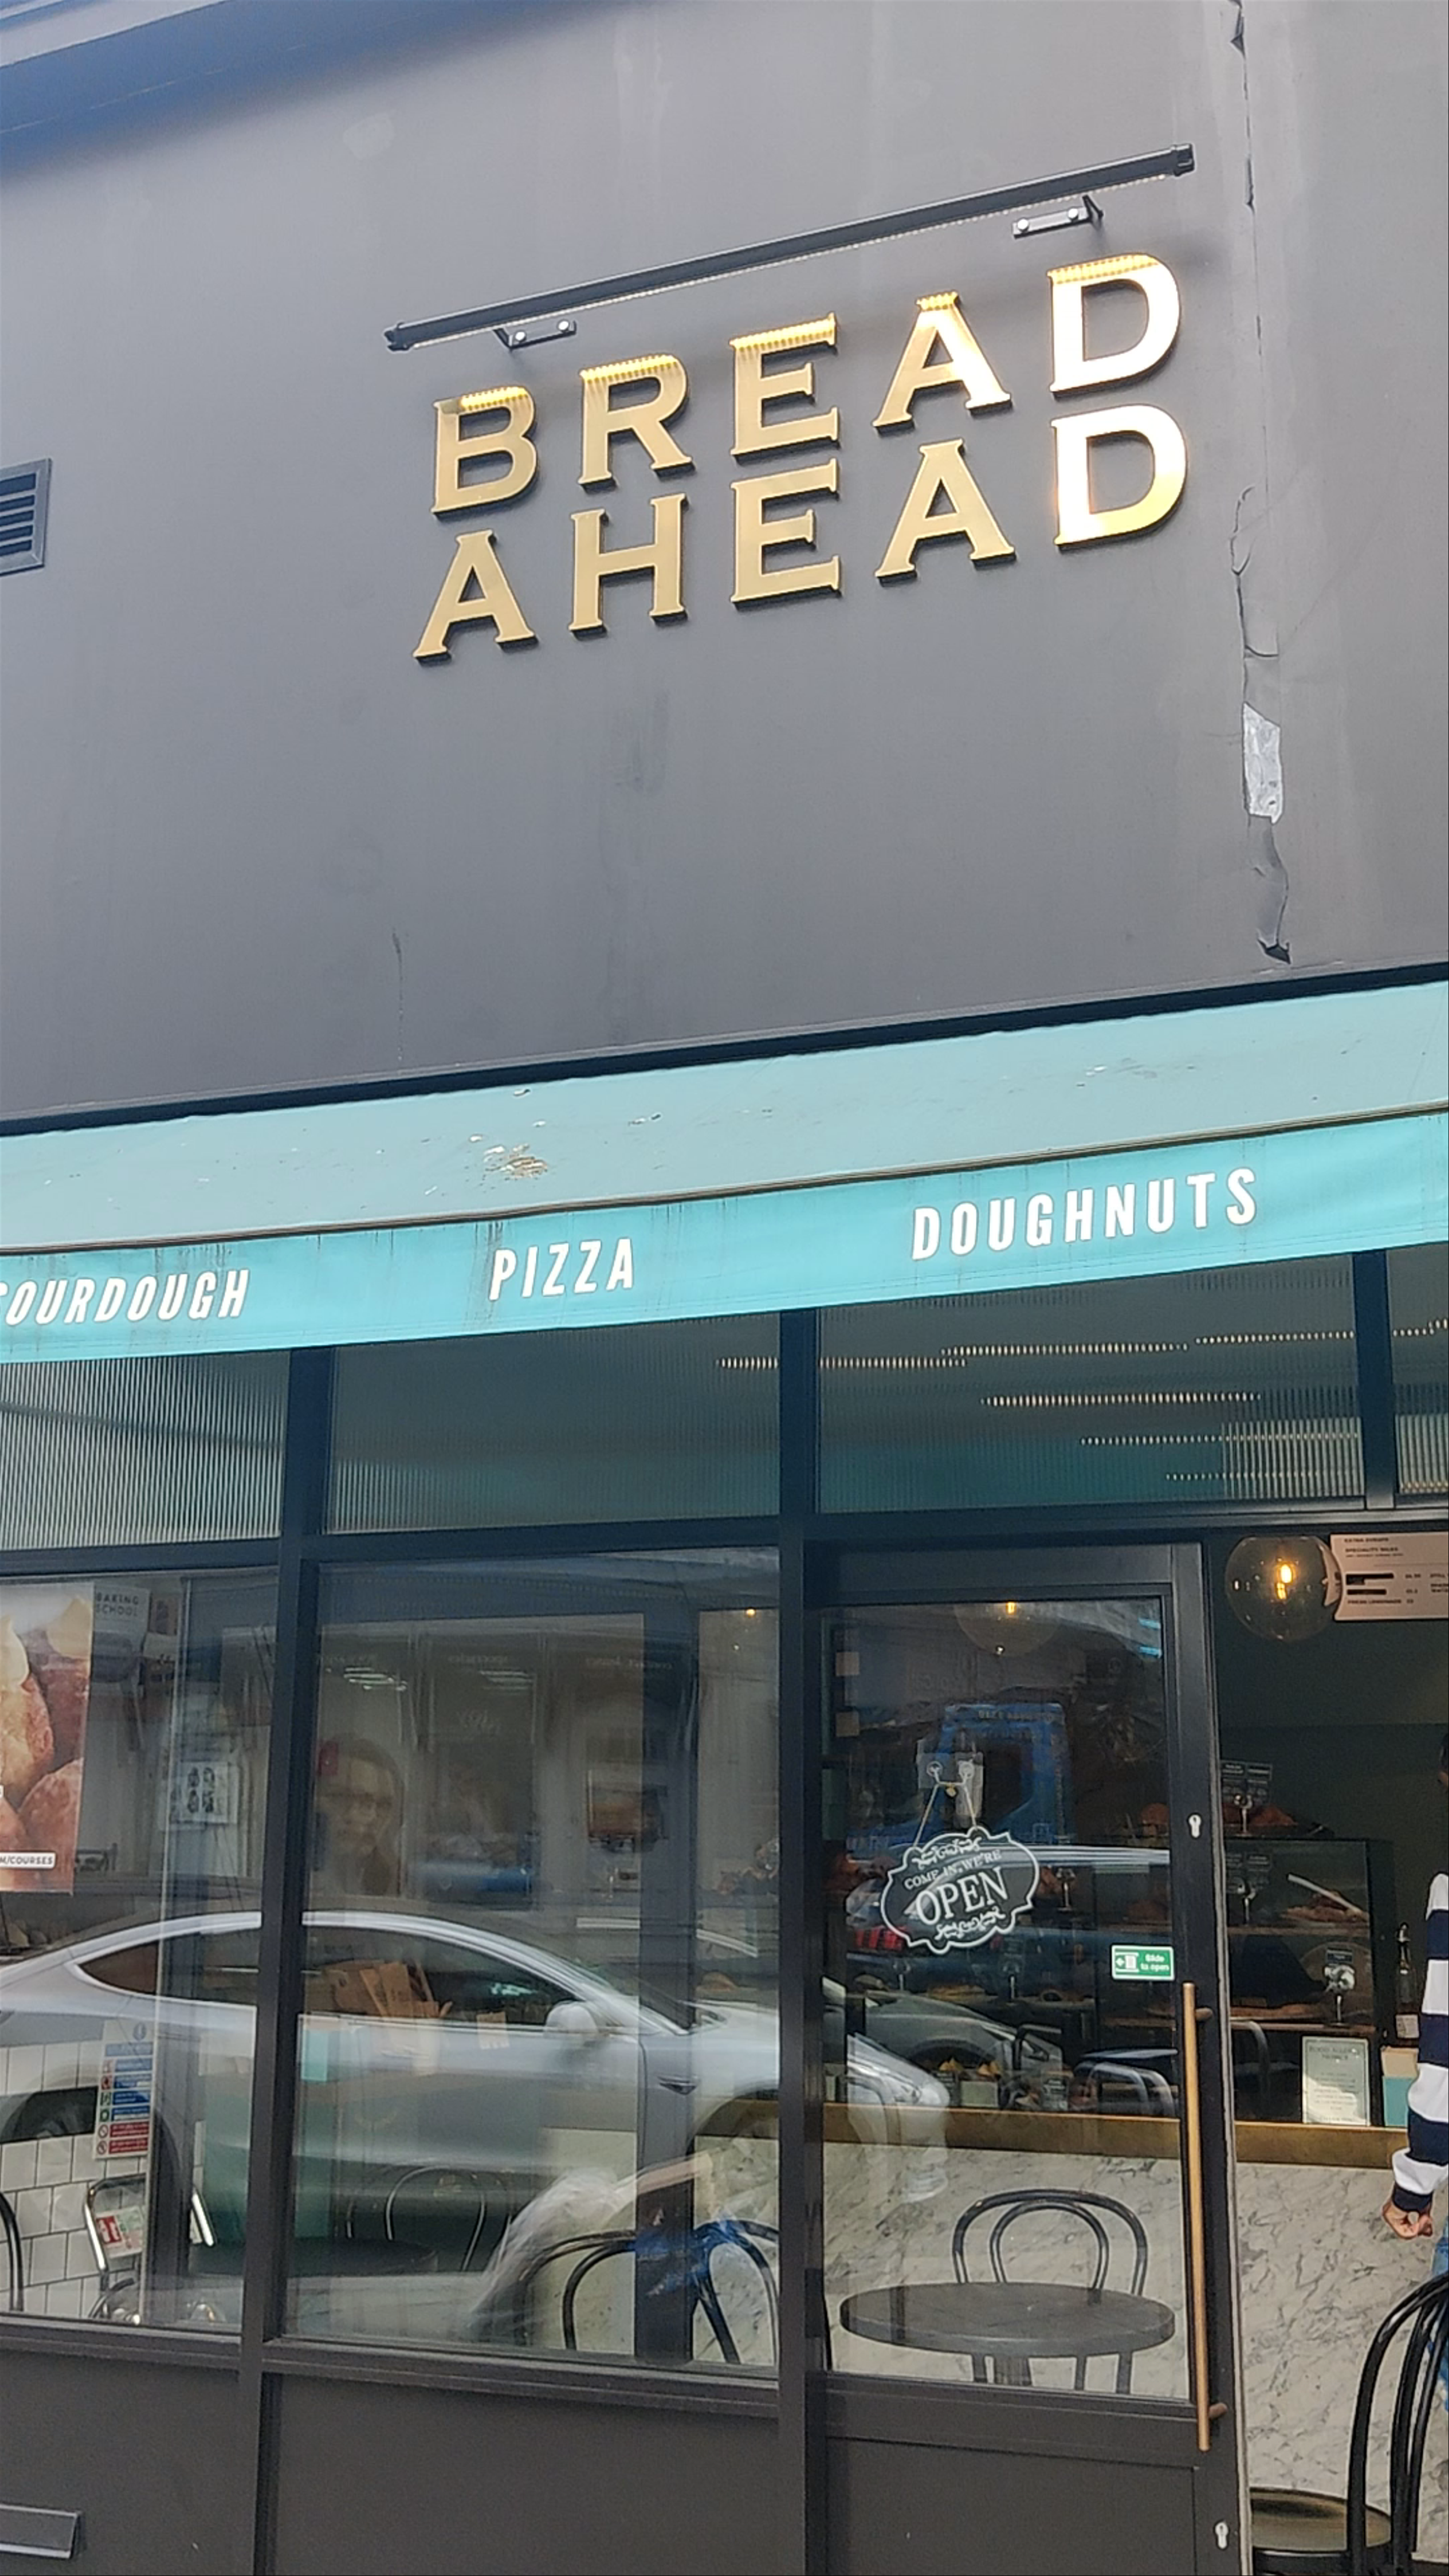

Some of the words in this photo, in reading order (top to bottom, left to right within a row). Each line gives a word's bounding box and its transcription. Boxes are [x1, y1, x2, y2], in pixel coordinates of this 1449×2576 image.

[431, 253, 1183, 519] BREAD
[412, 403, 1188, 663] AHEAD
[911, 1167, 1257, 1260] DOUGHNUTS
[0, 1269, 249, 1326] OURDOUGH
[489, 1237, 634, 1301] PIZZA
[96, 1604, 138, 1617] SCHOOL
[97, 1592, 138, 1605] BAKING
[904, 1869, 939, 1890] COME
[961, 1849, 1002, 1870] WE'RE
[916, 1866, 1008, 1925] OPEN
[1145, 1953, 1165, 1963] Slide
[1151, 1963, 1170, 1972] open
